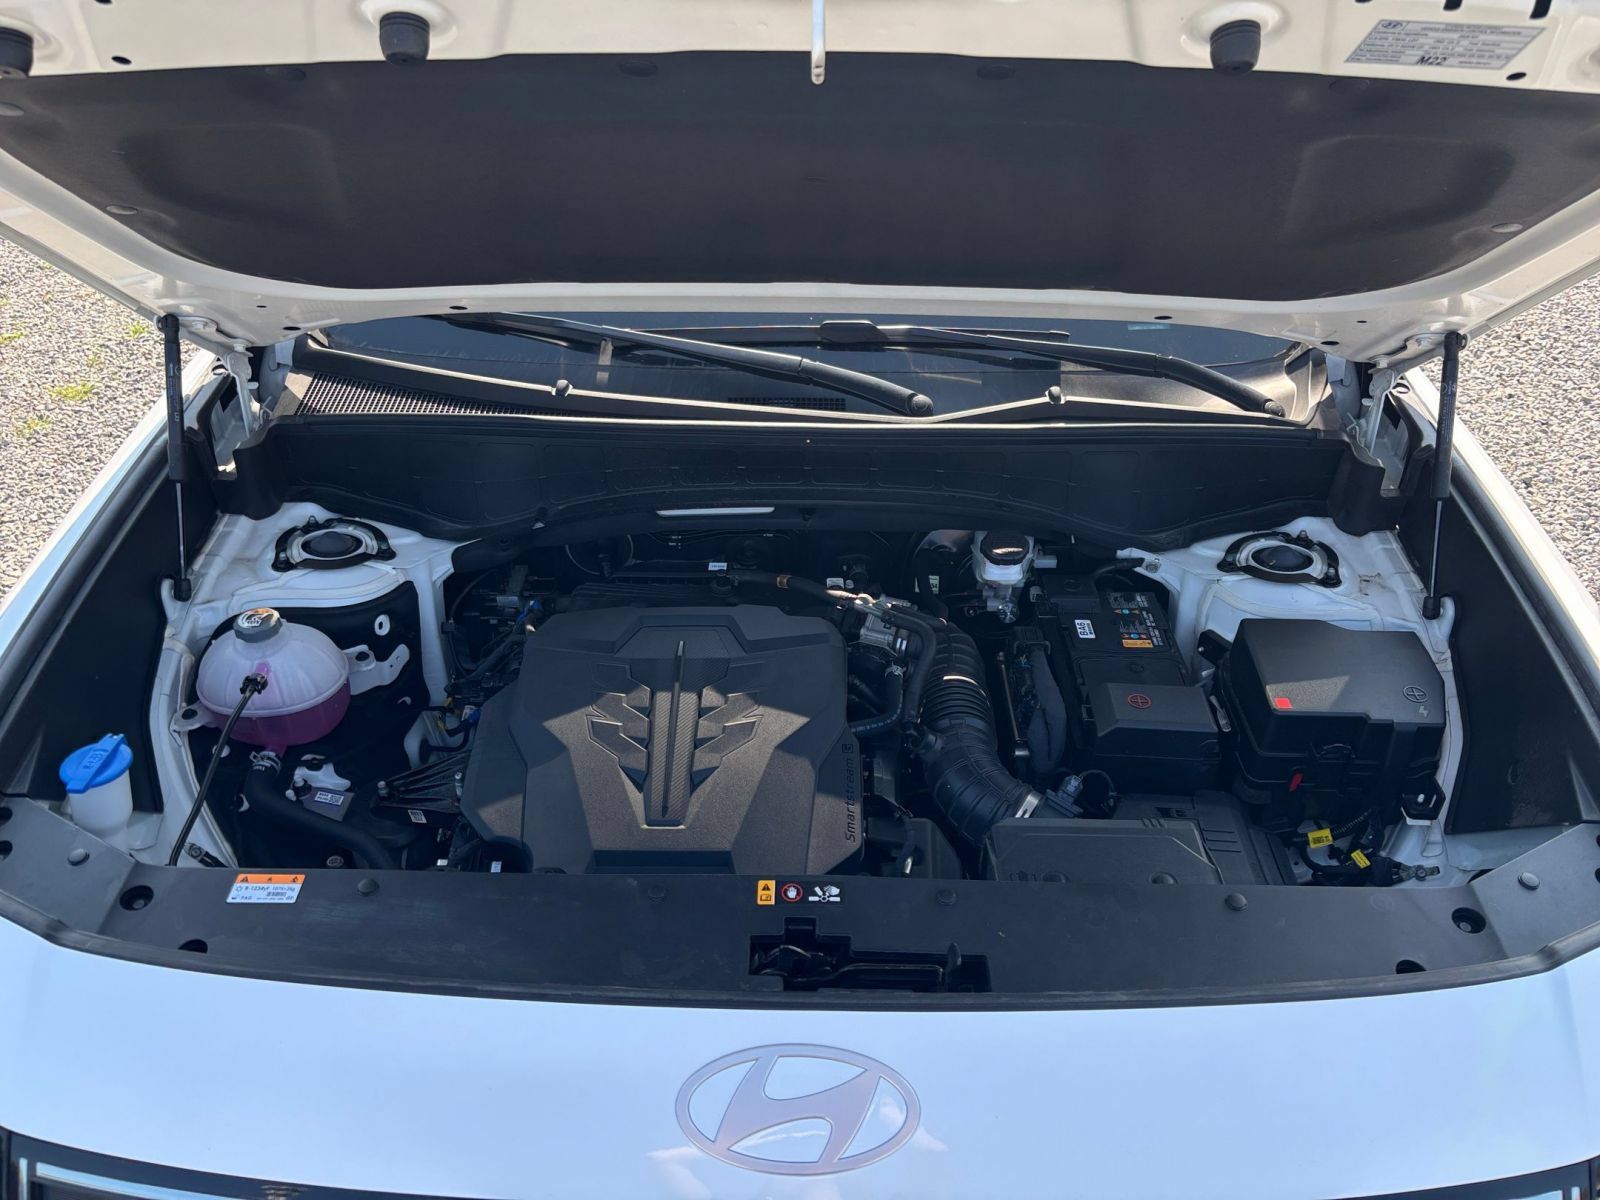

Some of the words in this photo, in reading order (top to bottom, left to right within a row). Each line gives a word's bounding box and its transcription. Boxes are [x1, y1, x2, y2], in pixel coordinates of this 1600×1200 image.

[1416, 56, 1448, 65] M22
[1076, 622, 1089, 636] BA6
[845, 758, 856, 842] Smartstream
